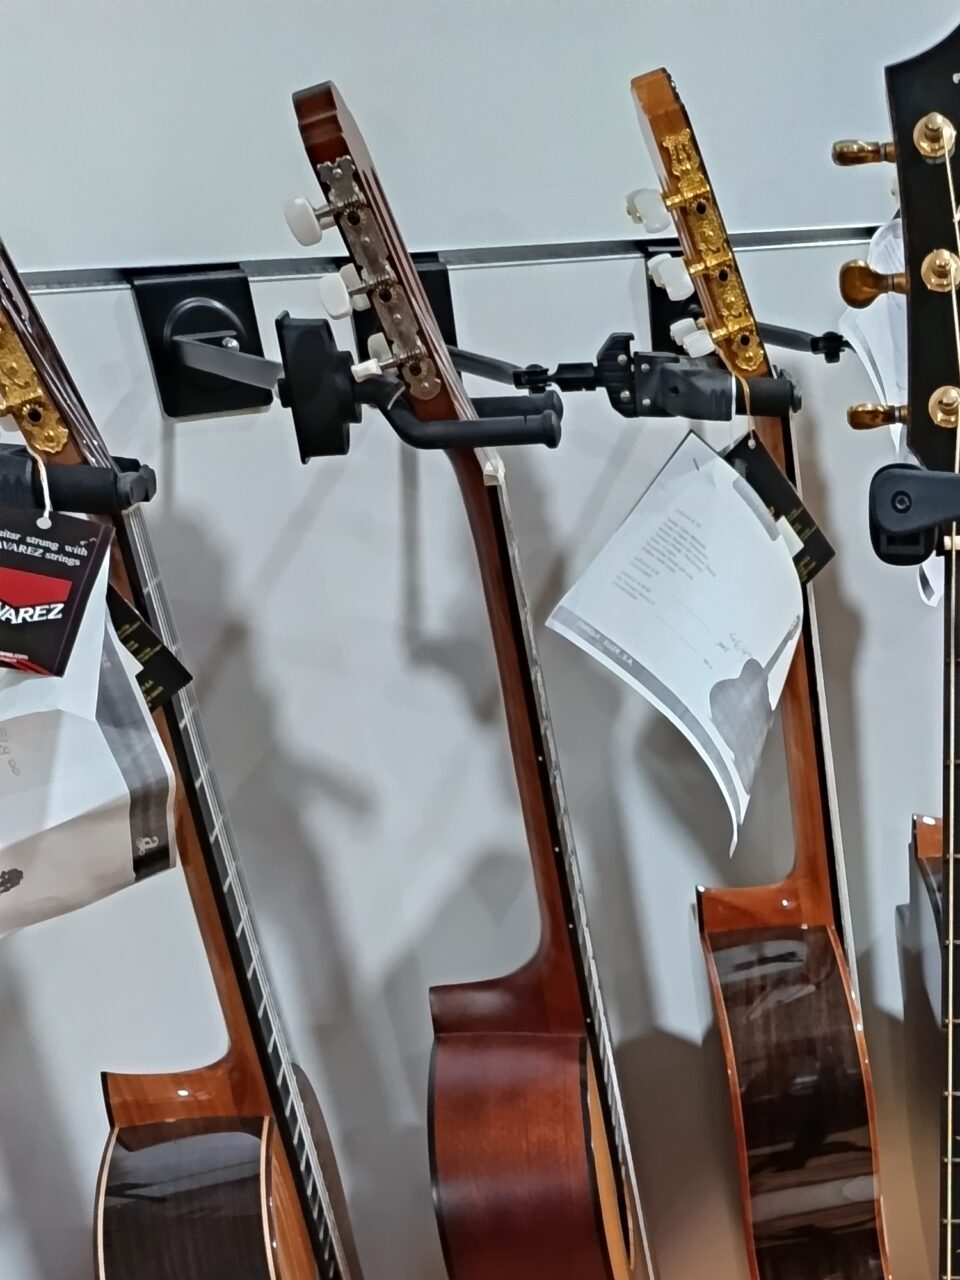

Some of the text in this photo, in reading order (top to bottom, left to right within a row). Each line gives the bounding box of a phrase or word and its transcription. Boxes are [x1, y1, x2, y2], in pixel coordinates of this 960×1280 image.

[26, 535, 60, 551] strung
[64, 544, 89, 557] with
[45, 550, 81, 567] strings
